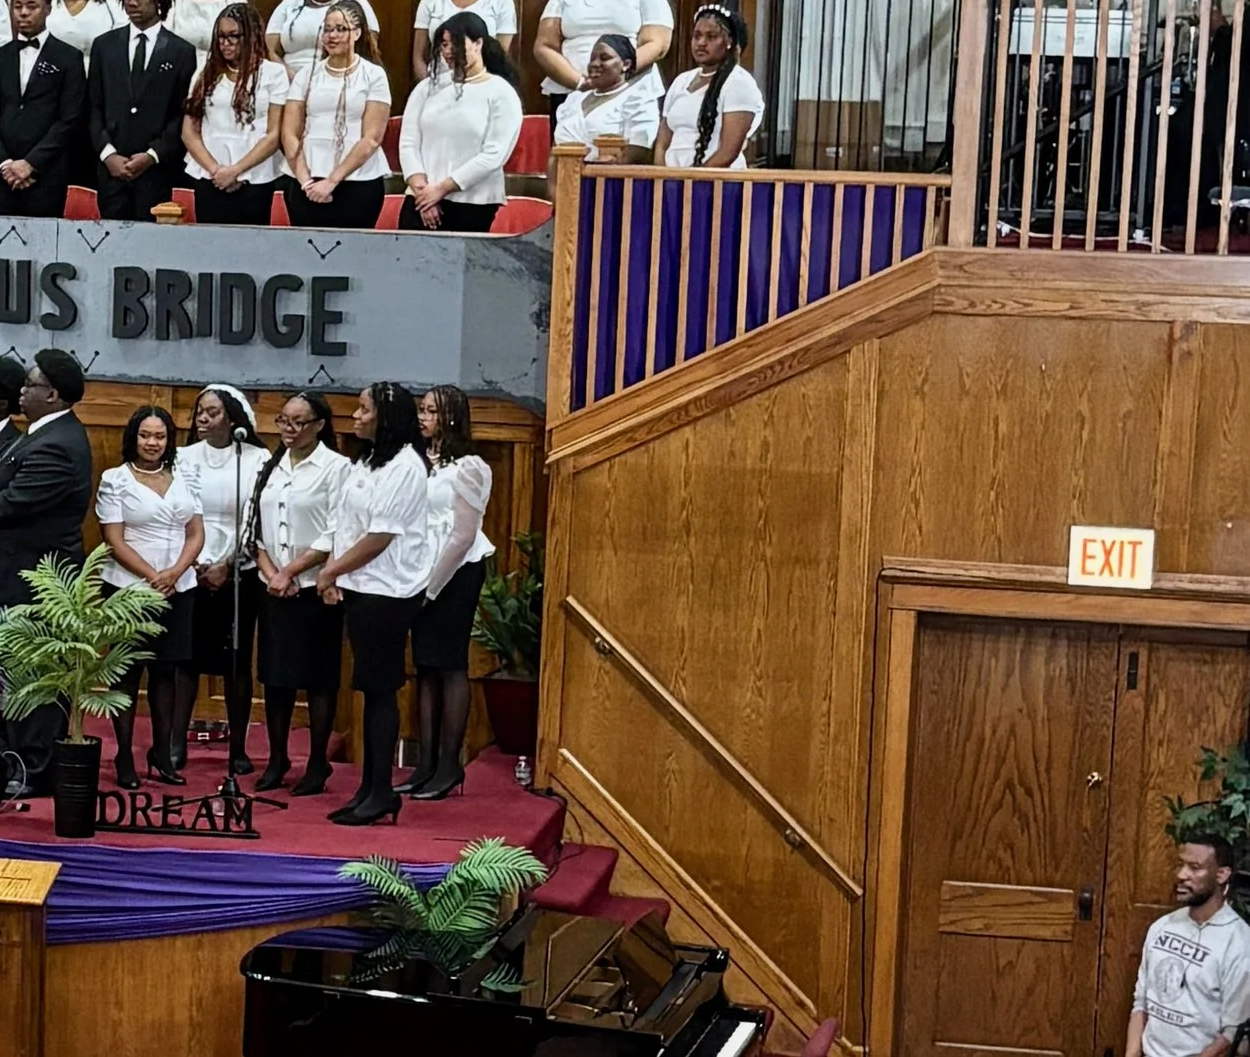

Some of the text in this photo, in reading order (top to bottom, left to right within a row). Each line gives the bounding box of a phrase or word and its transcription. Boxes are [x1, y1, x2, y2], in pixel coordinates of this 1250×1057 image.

[112, 266, 350, 356] BRIDGE
[1081, 538, 1143, 579] EXIT
[96, 790, 253, 831] DREAM
[1155, 934, 1211, 962] NCCU
